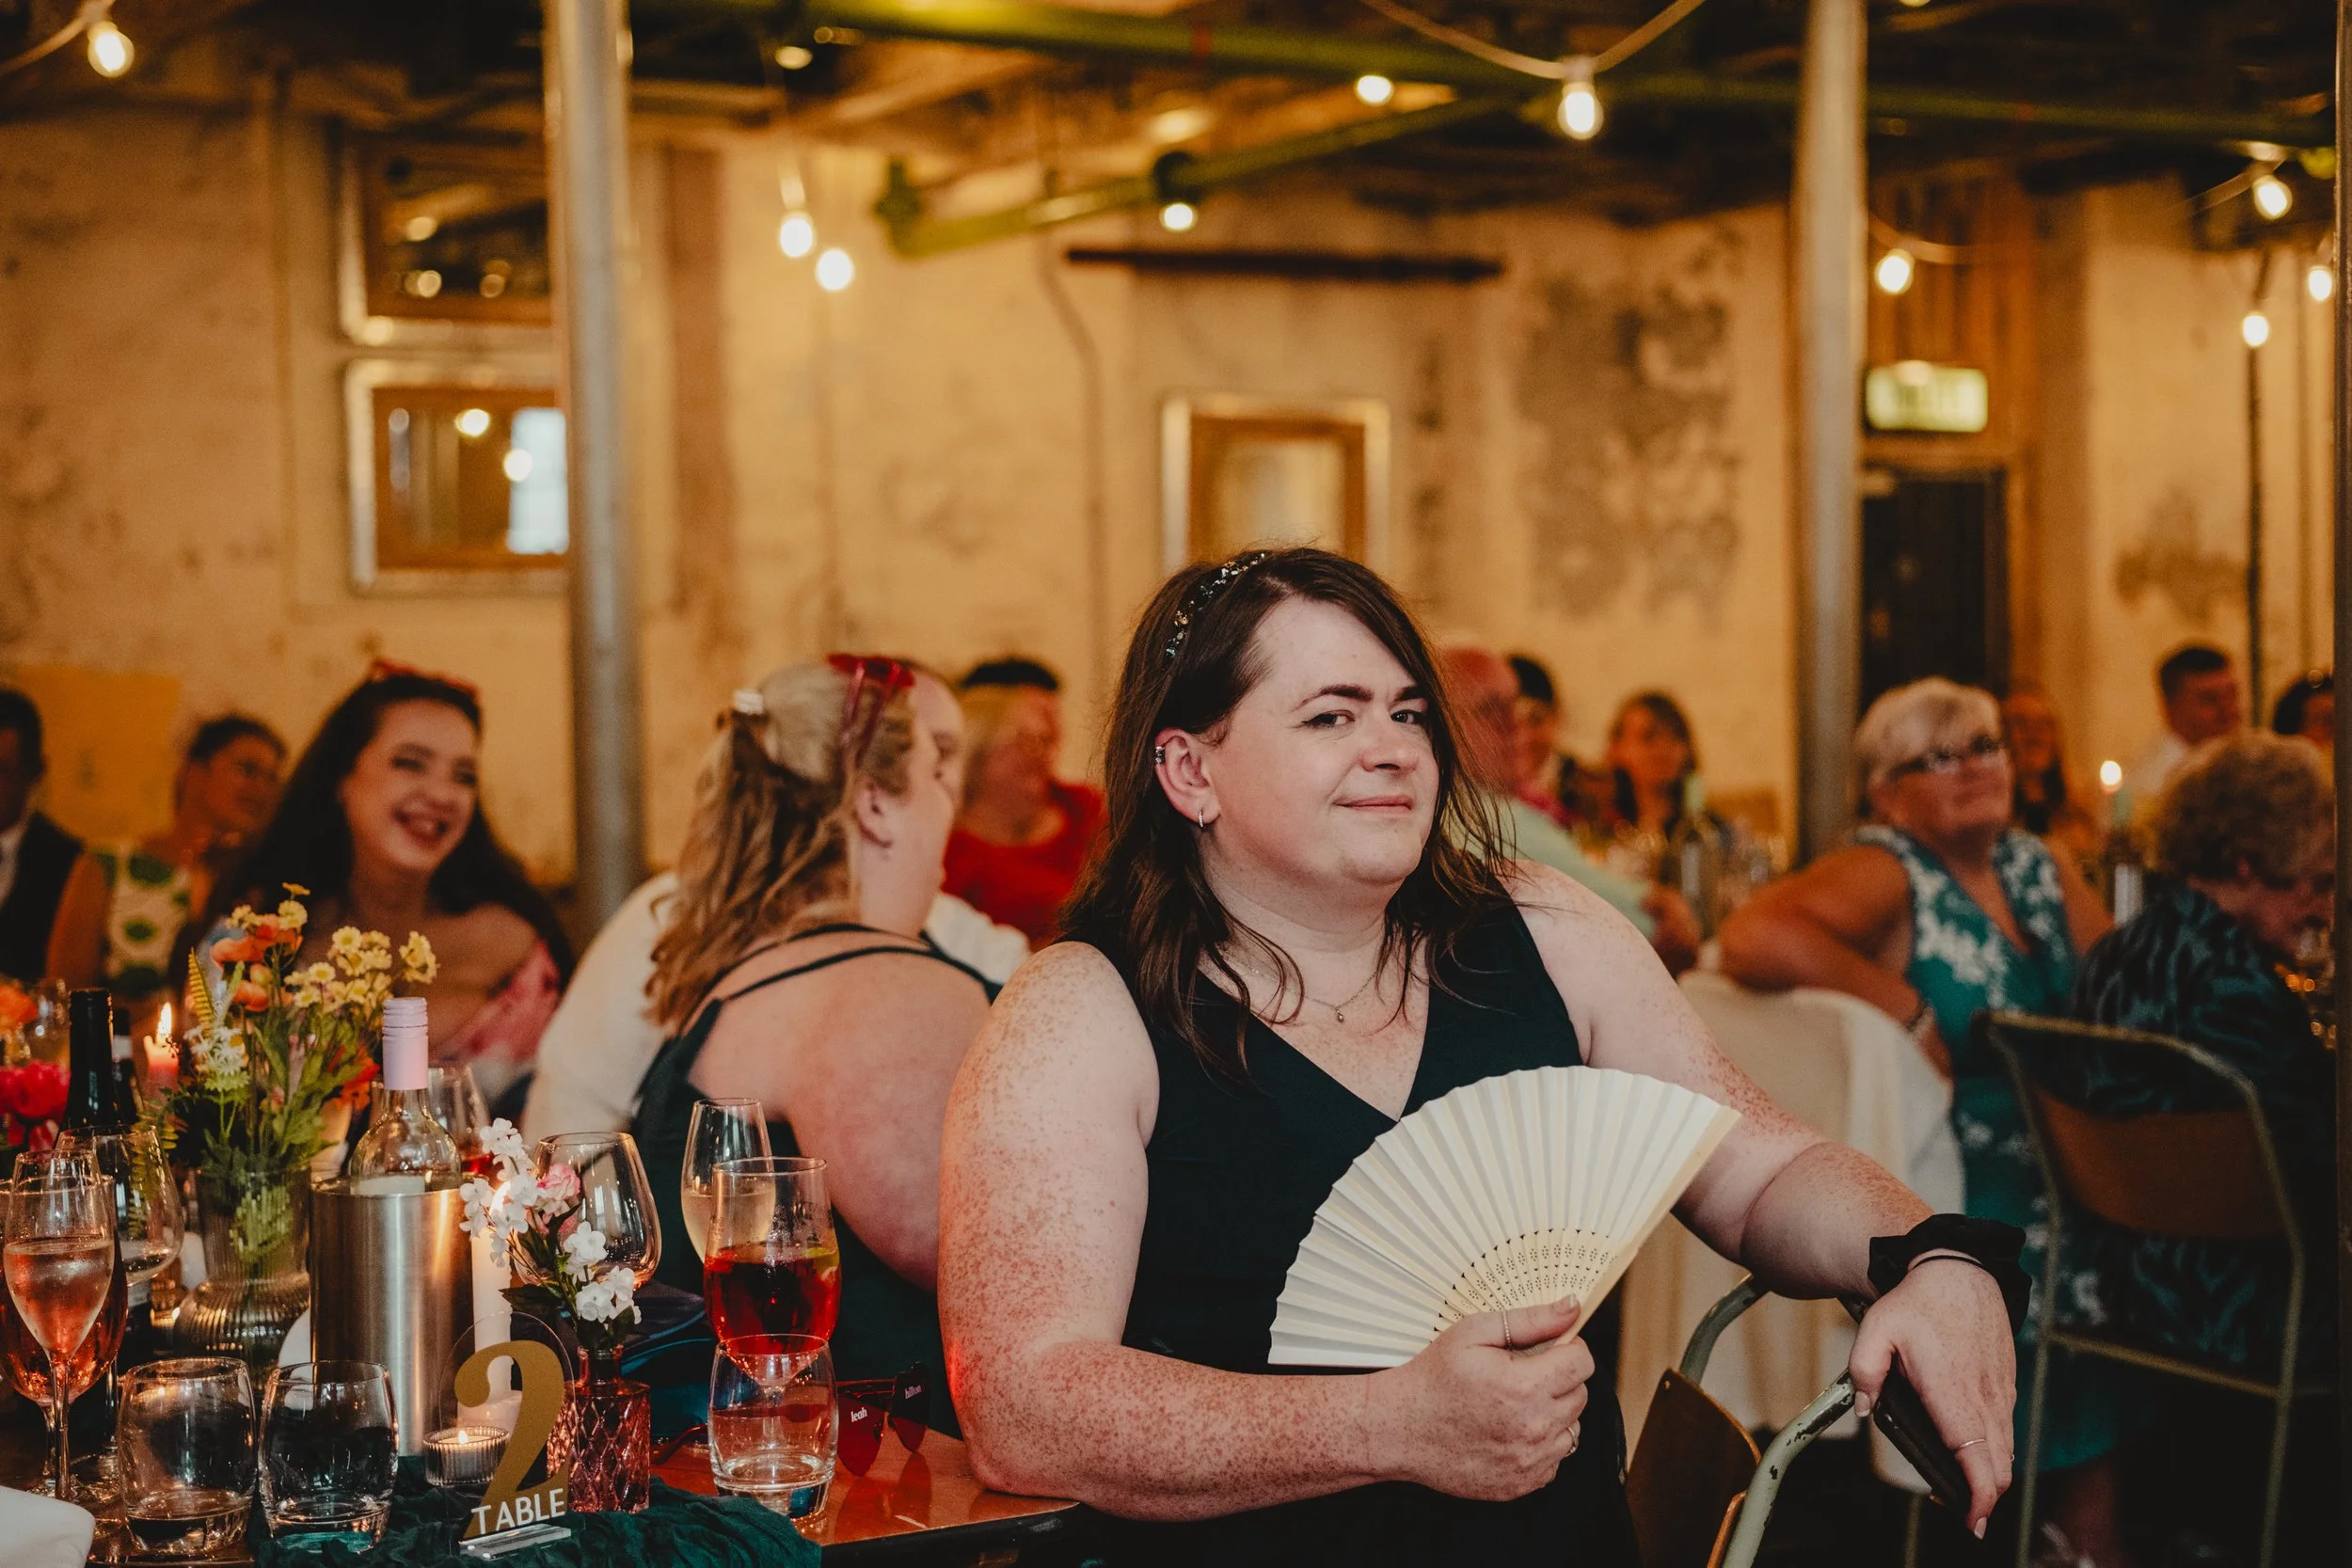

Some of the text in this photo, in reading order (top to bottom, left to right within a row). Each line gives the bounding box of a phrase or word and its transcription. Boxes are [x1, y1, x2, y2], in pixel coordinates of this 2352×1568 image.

[850, 1407, 867, 1422] leah
[454, 1340, 569, 1538] 2
[471, 1488, 564, 1535] TABLE
